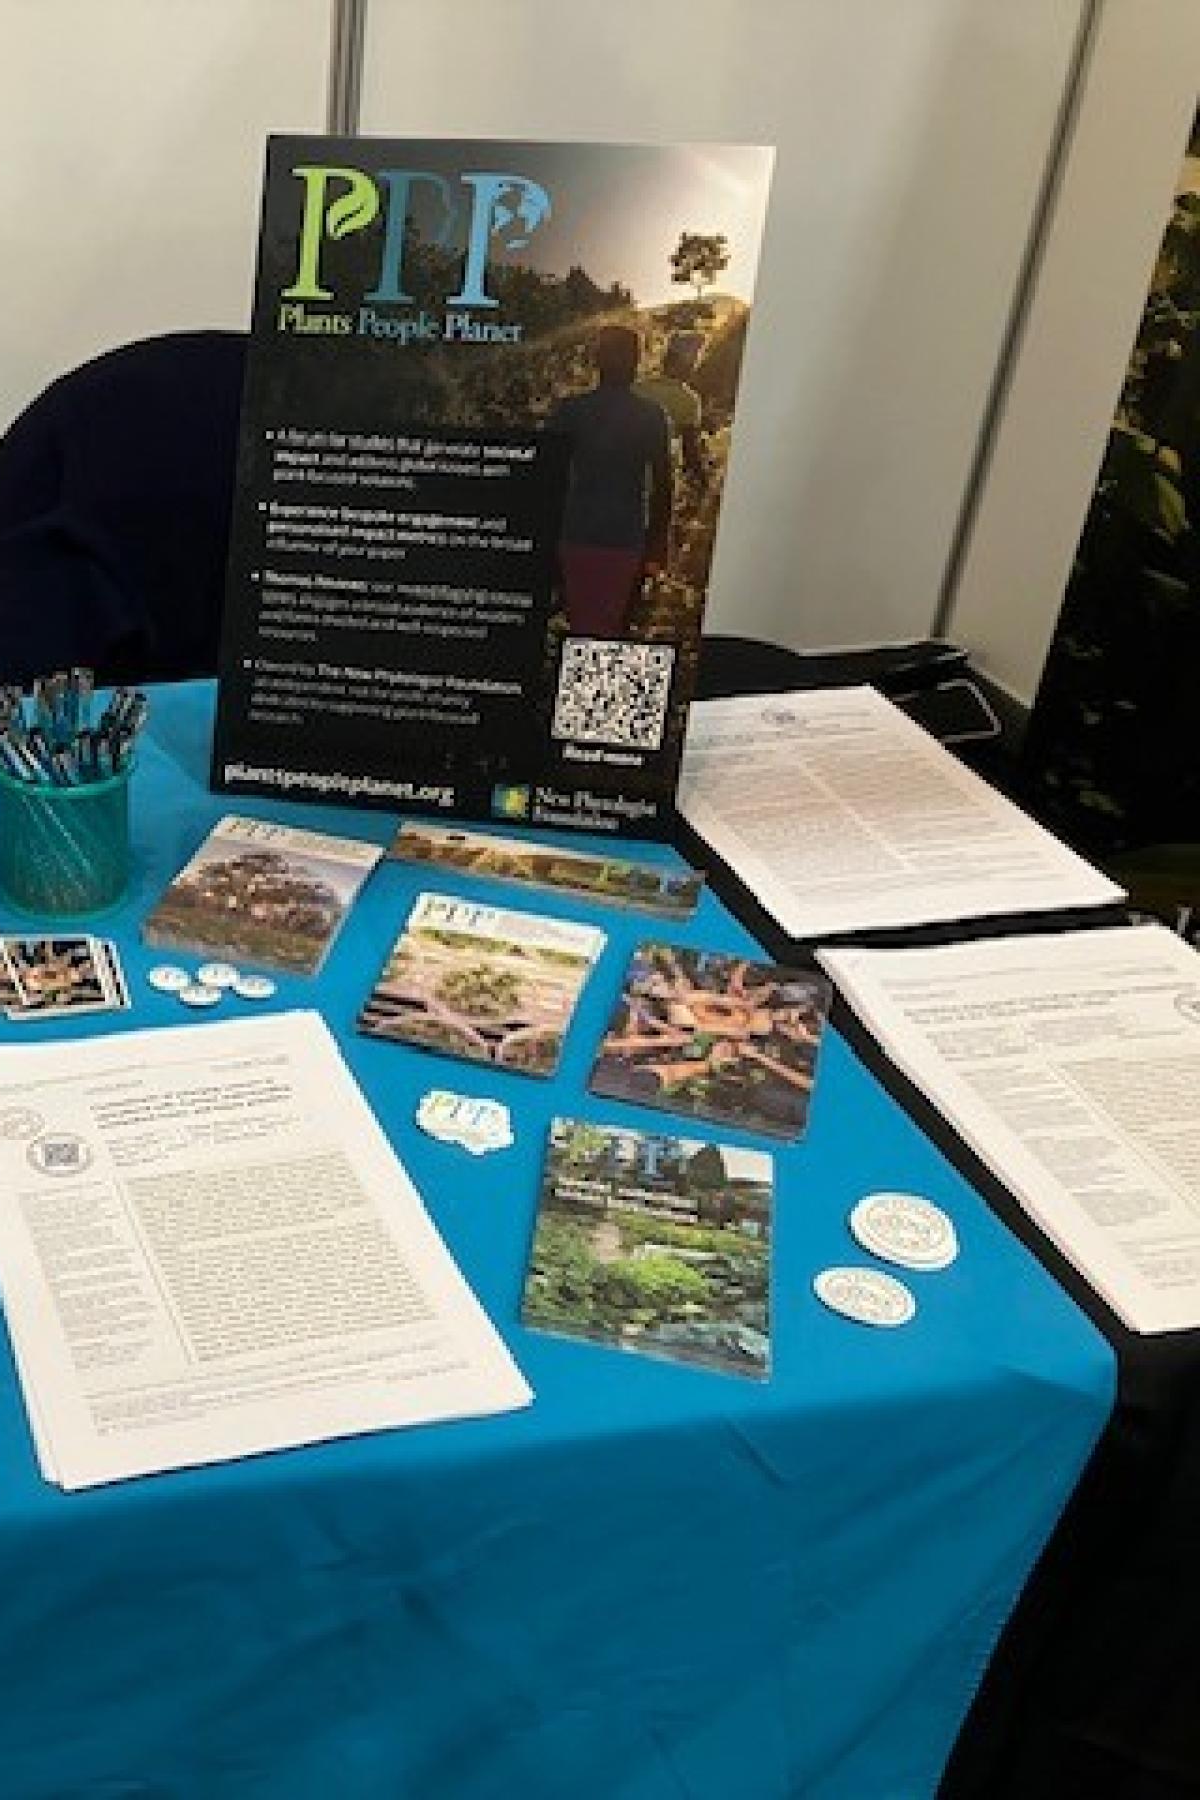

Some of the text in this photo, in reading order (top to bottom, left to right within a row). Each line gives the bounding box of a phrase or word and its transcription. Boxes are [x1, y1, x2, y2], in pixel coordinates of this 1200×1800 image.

[280, 165, 553, 308] PPP
[278, 303, 524, 345] Plants People Planet
[535, 786, 571, 808] New
